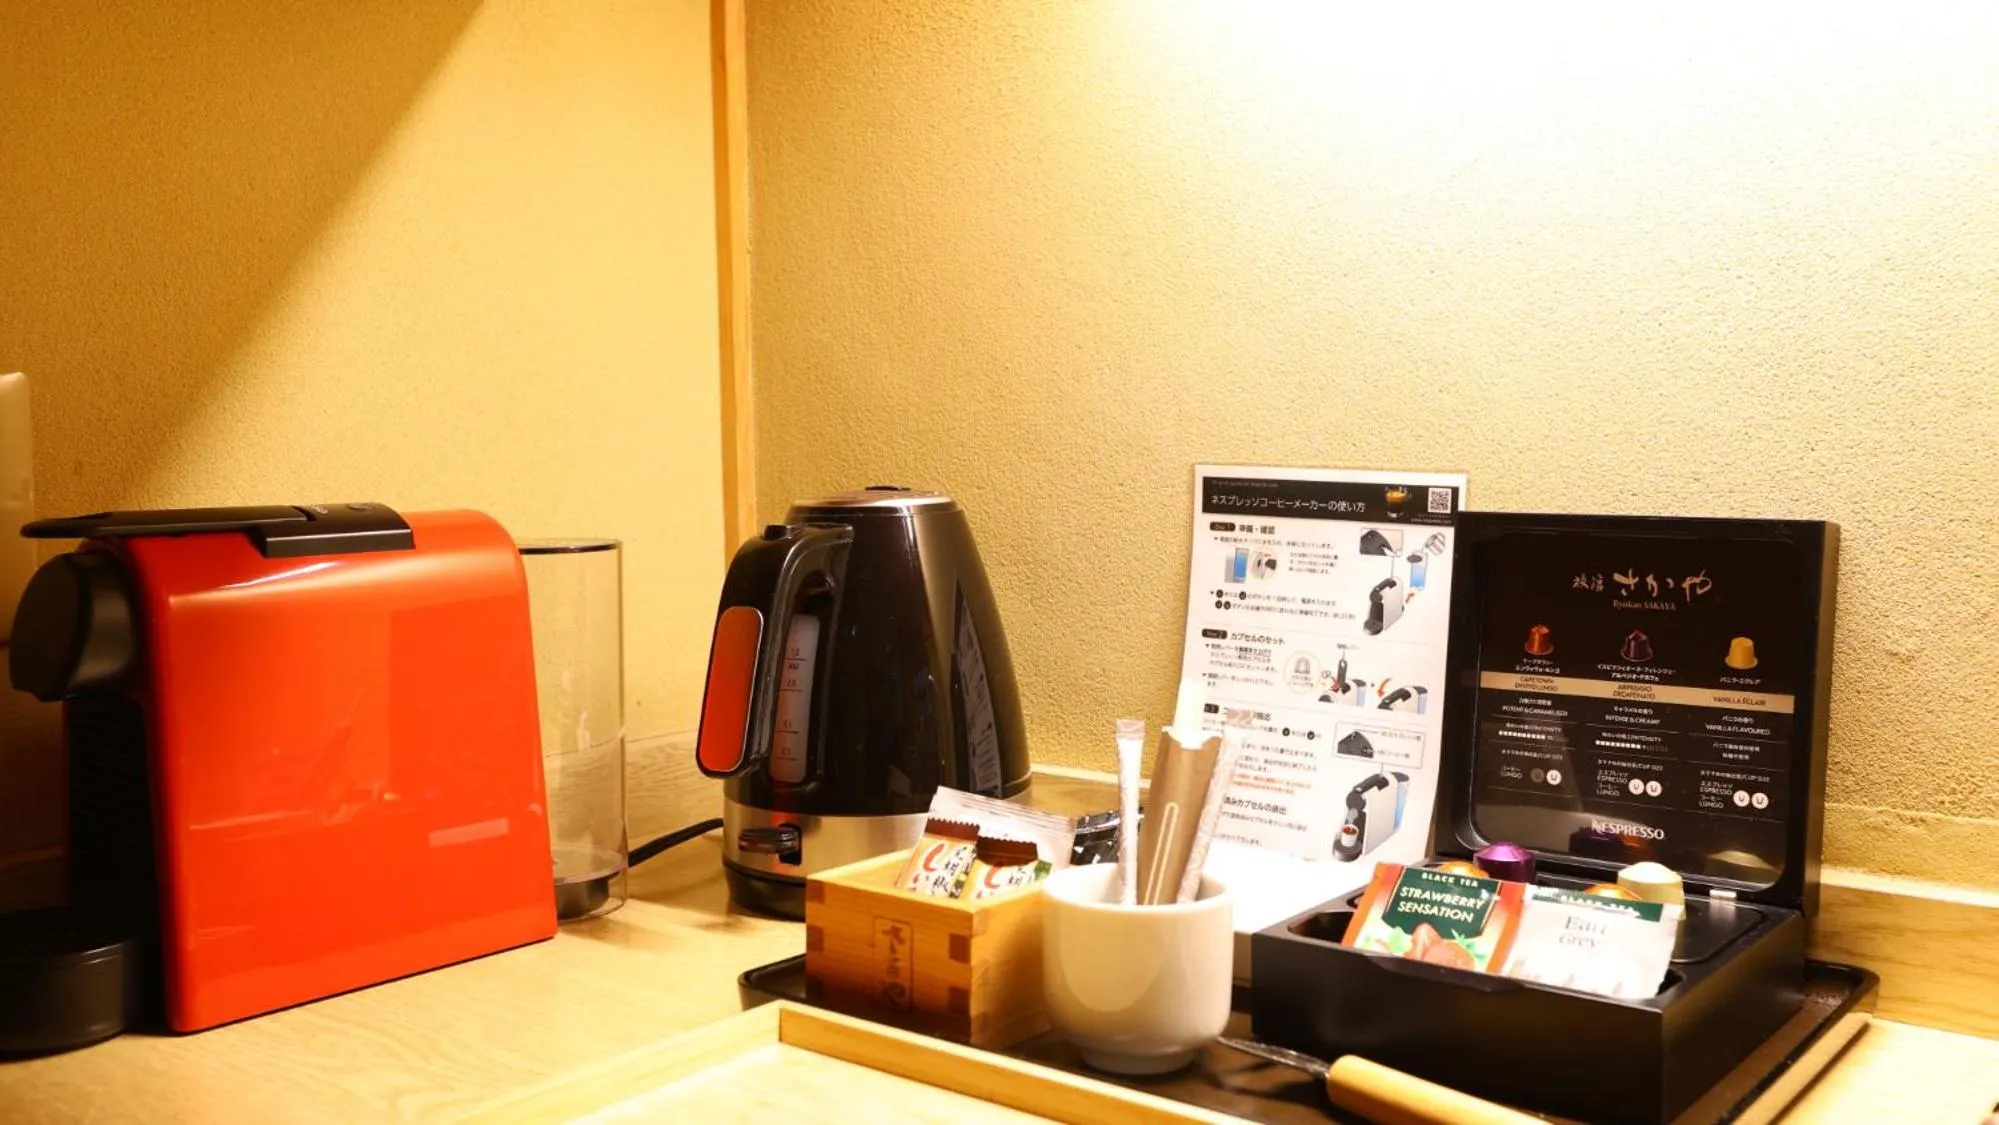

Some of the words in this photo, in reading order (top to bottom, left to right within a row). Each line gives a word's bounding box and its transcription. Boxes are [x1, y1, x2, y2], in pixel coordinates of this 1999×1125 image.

[1211, 495, 1365, 513] ネスプレッソコーヒーメーカーの使い方
[1713, 695, 1741, 704] VANILLA
[1700, 786, 1732, 795] ESPRESSO
[1699, 801, 1724, 809] LUNGO
[1591, 819, 1665, 840] NESPRESSO
[1421, 872, 1456, 884] BLACK
[1460, 877, 1479, 888] TEA
[1400, 886, 1485, 910] STRAWBERRY
[1398, 901, 1474, 922] SENSATION
